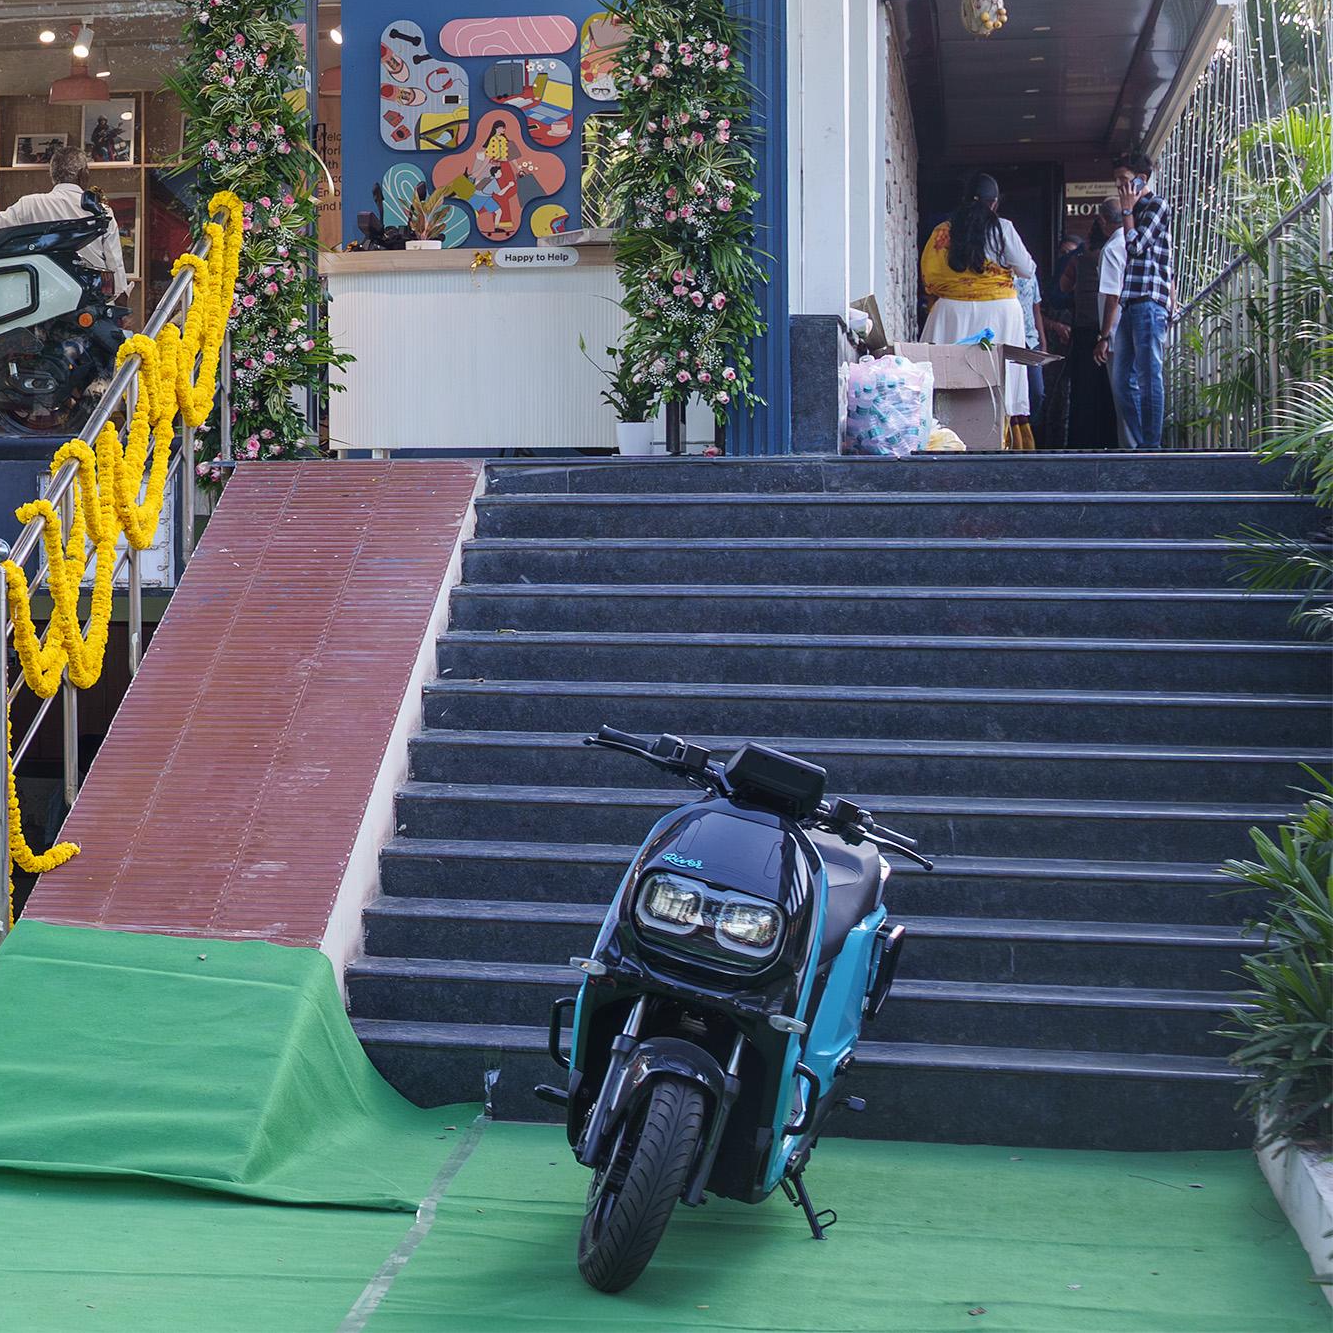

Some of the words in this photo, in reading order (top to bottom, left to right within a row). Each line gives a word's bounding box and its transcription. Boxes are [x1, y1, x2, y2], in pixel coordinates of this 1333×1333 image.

[504, 254, 534, 262] Happy
[547, 253, 569, 262] Help
[662, 853, 704, 870] River
